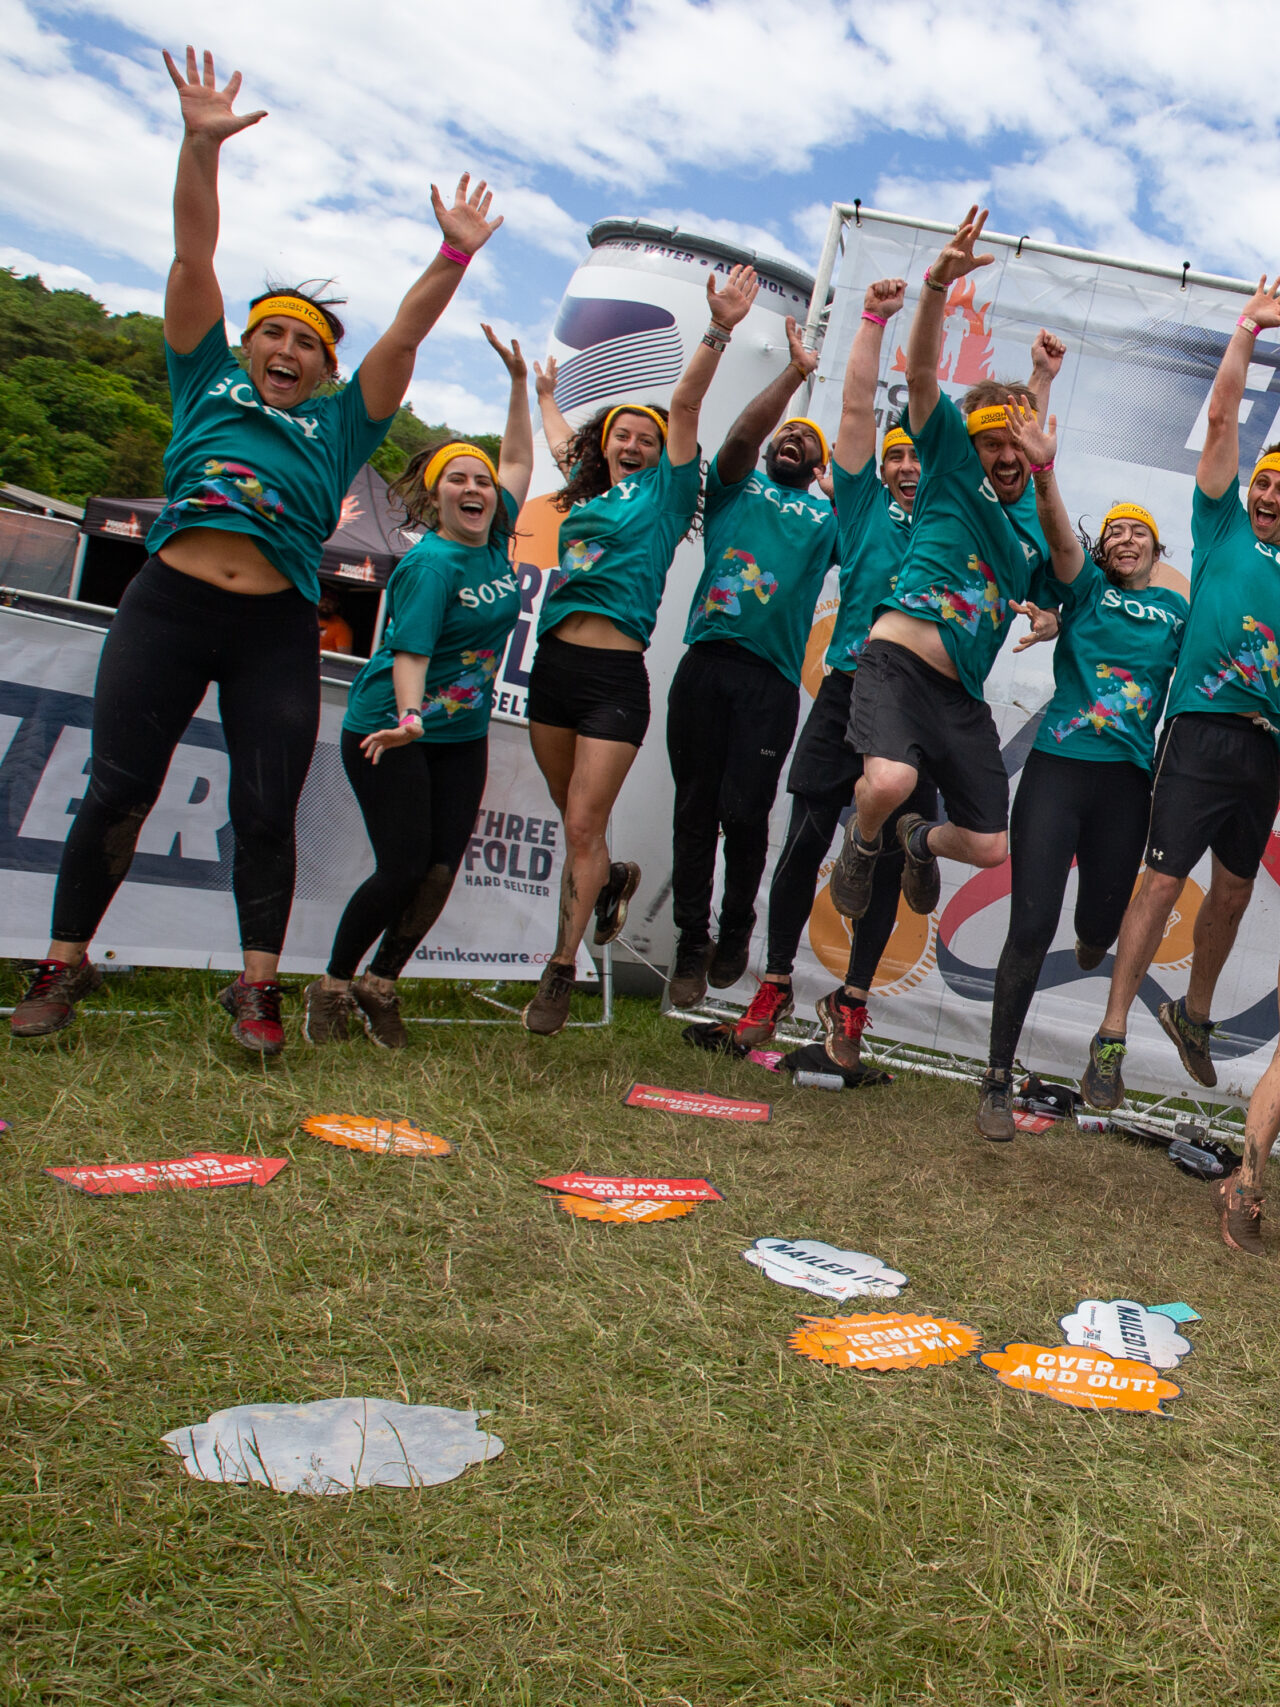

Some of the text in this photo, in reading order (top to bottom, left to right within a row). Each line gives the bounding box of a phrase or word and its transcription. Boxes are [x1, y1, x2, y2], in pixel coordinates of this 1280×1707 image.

[644, 243, 695, 264] WATER
[714, 261, 787, 299] ALHOL
[458, 573, 519, 609] SON
[1100, 588, 1185, 635] SONY
[473, 808, 559, 847] THREE
[464, 837, 553, 882] FOLD
[465, 874, 550, 898] HARD SELTZER
[415, 945, 553, 964] drinkaware.co
[636, 1092, 763, 1114] BERRYLICIOUS!
[669, 1103, 709, 1114] RED
[72, 1158, 222, 1181] FLOW YOUR
[592, 1188, 711, 1198] FLOW YOUR
[621, 1182, 671, 1191] OWN
[766, 1243, 857, 1276] NAILED
[847, 1322, 943, 1348] CITRUS!
[1116, 1304, 1147, 1348] NAILED
[845, 1333, 962, 1364] I'M ZESTY
[1035, 1352, 1115, 1375] OVER
[1010, 1365, 1157, 1393] AND OUT!
